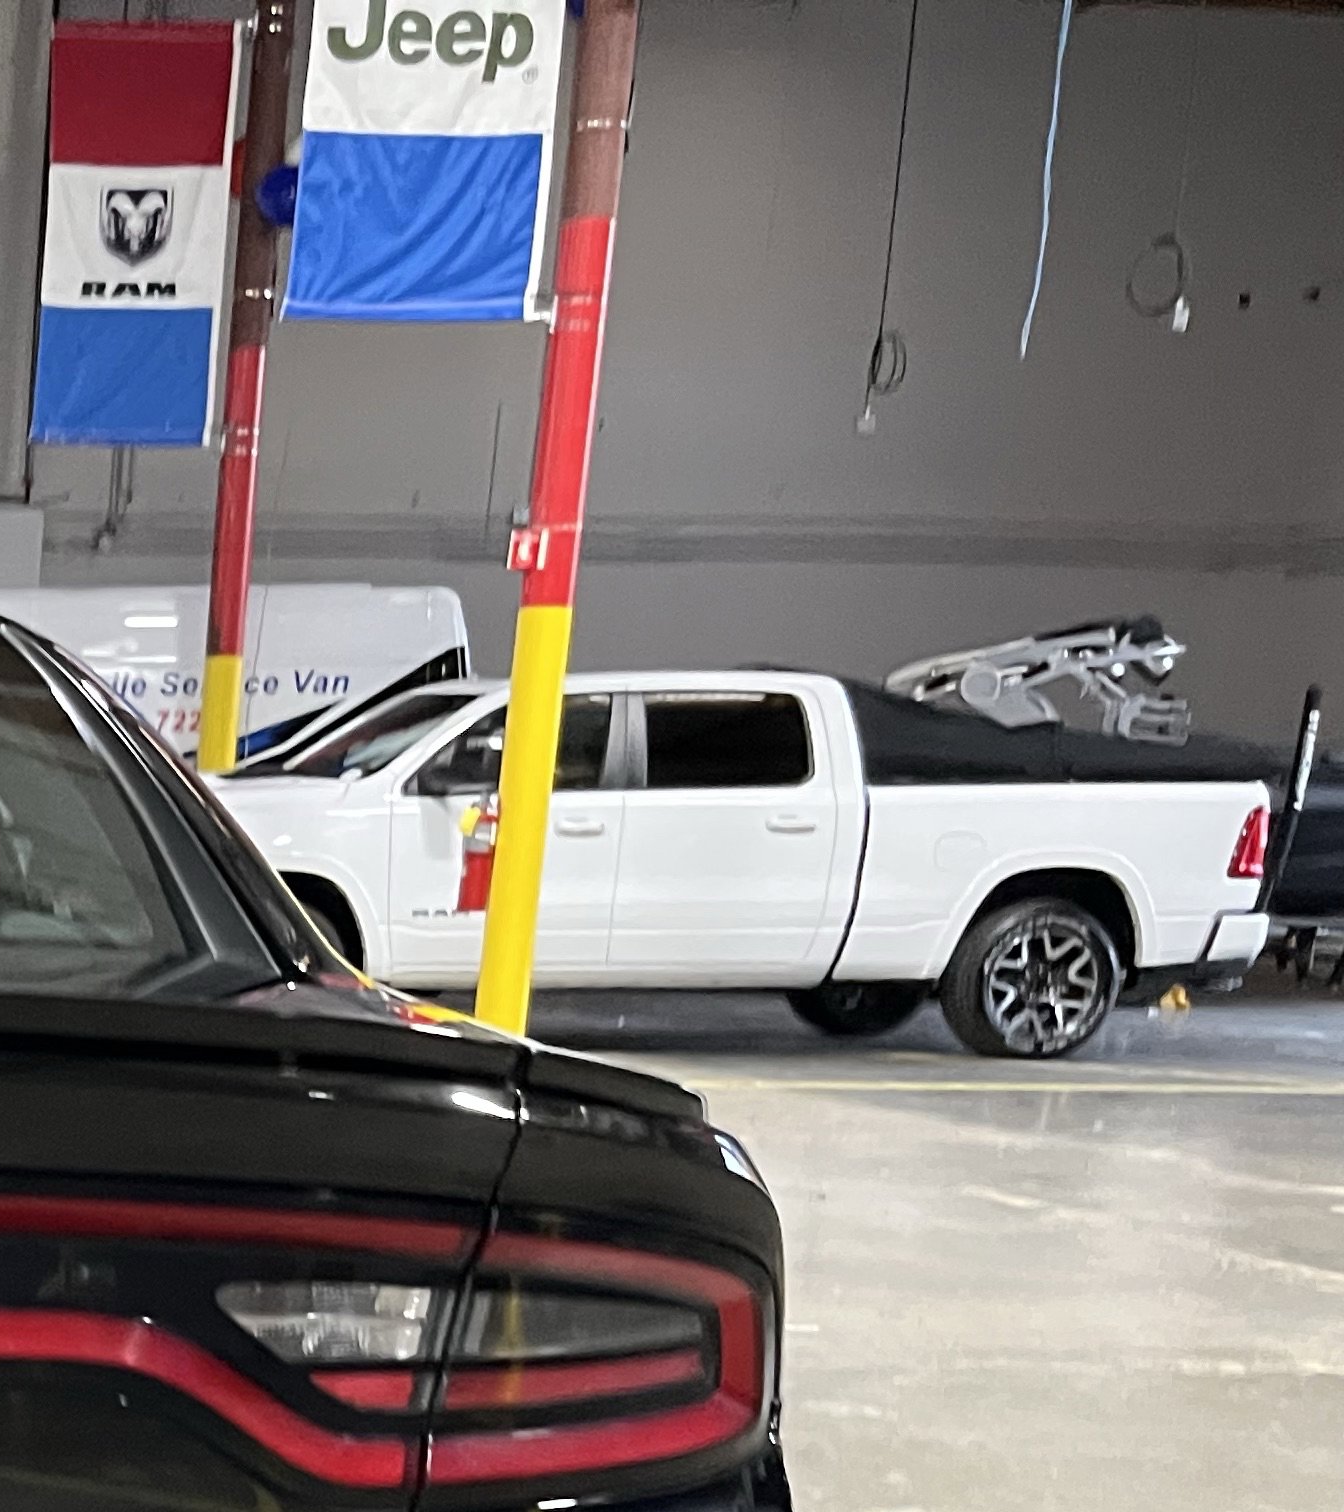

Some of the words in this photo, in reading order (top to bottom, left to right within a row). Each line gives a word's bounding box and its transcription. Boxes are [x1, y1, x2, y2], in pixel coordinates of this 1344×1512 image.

[326, 0, 534, 83] Jeep
[80, 281, 177, 298] RAM
[160, 672, 279, 698] Sece
[294, 669, 350, 694] Van
